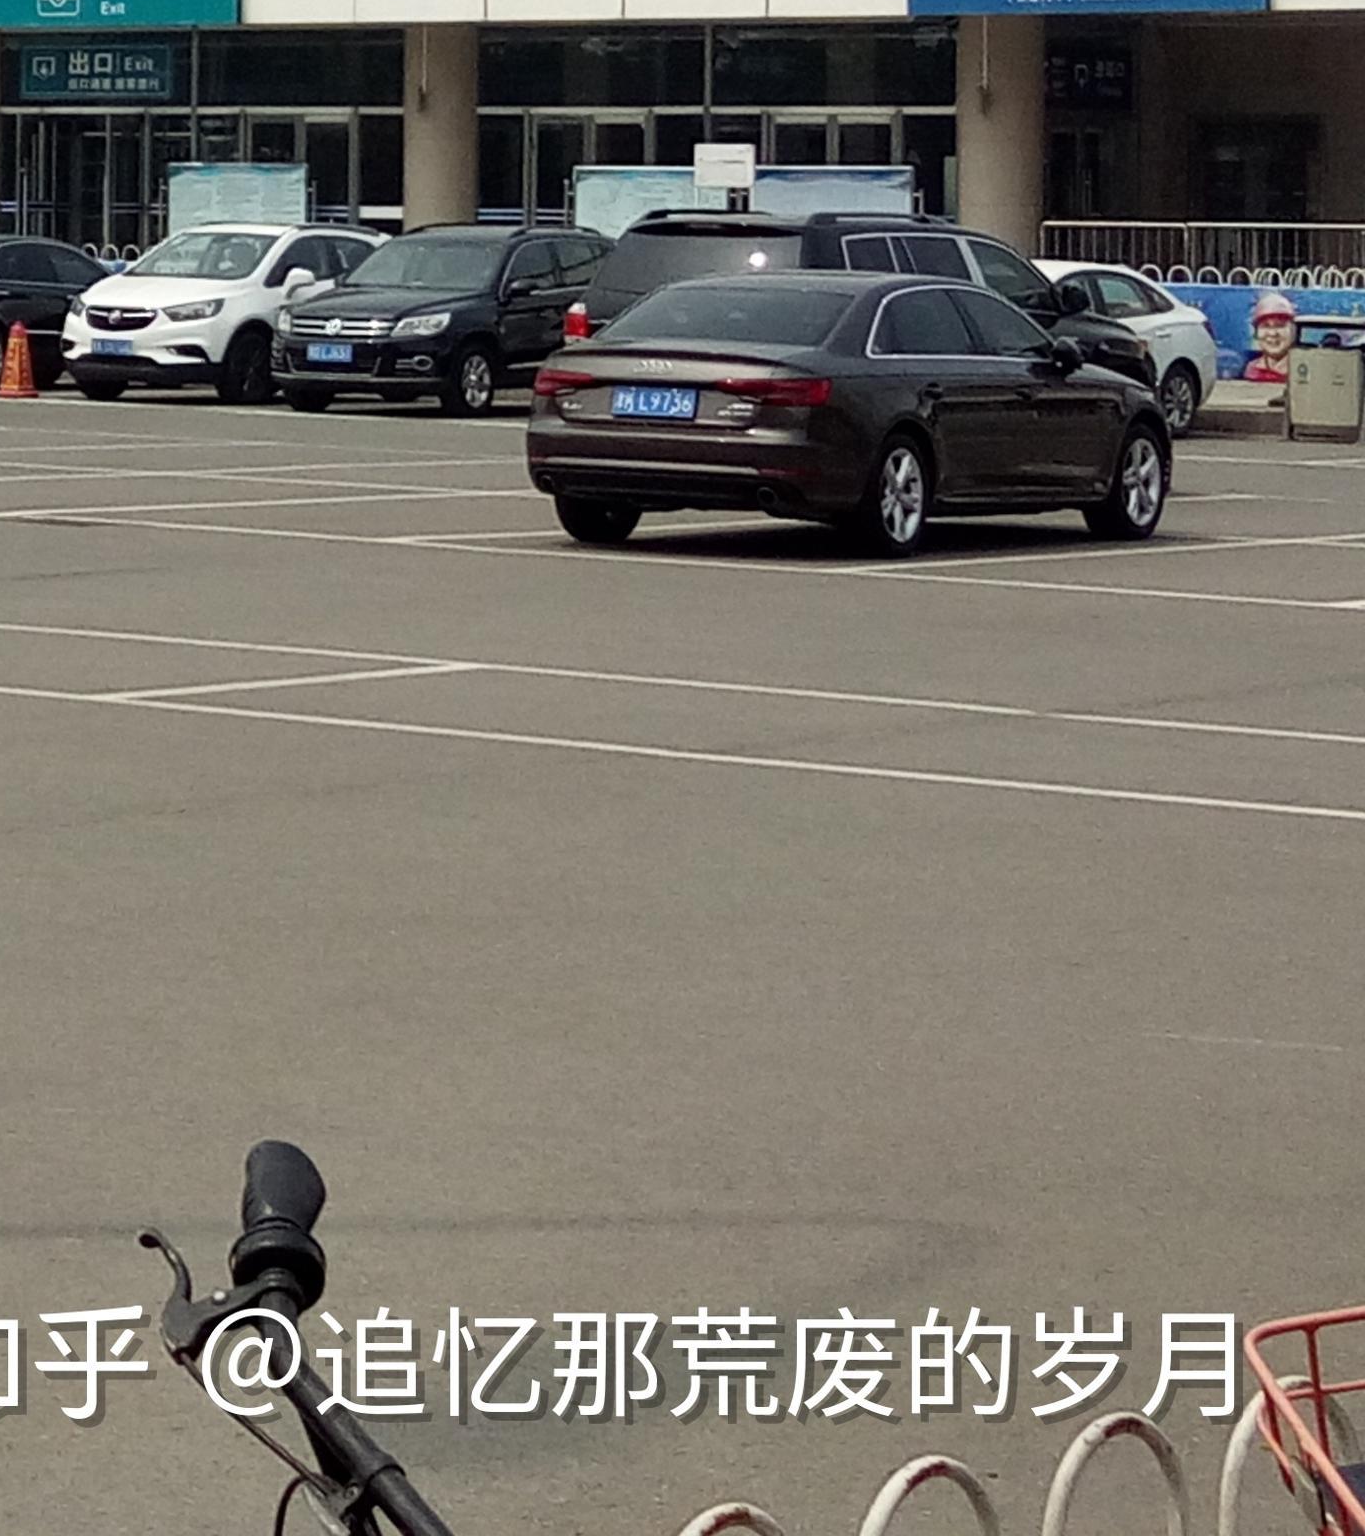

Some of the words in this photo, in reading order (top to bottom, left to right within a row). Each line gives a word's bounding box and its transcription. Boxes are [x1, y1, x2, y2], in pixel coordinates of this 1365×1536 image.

[101, 1, 125, 15] Exit
[68, 50, 113, 75] 出口
[123, 55, 154, 72] Exit
